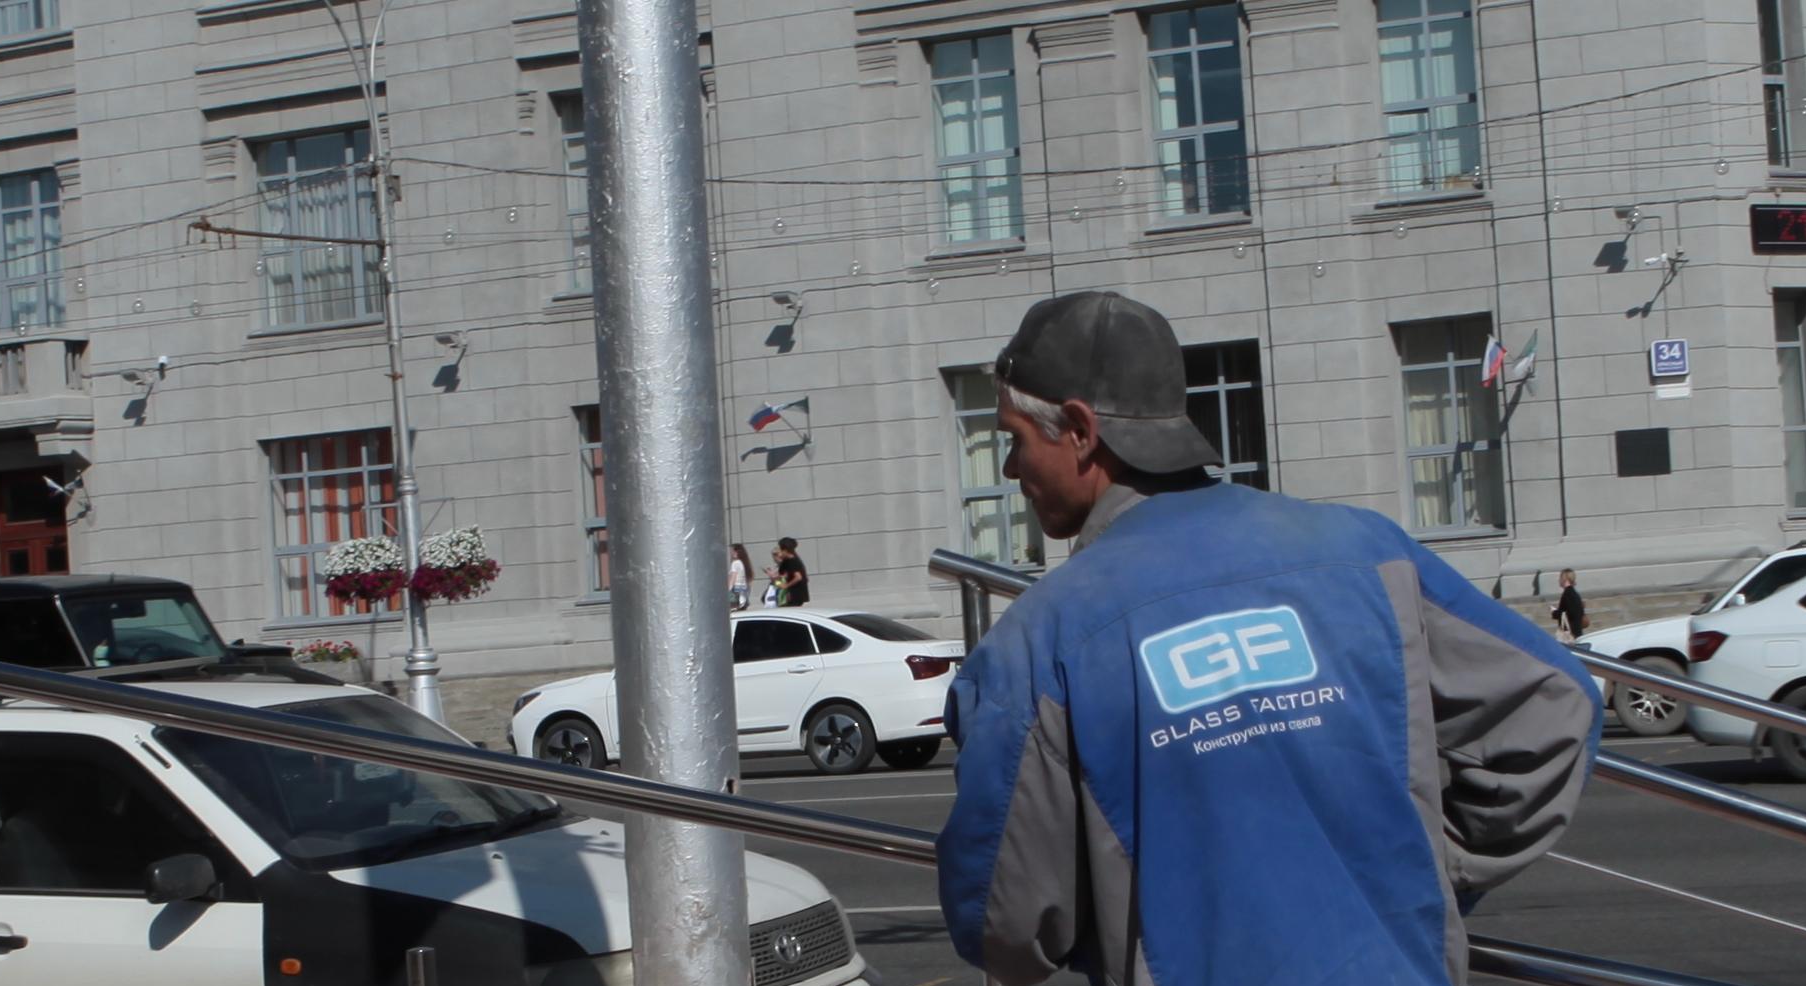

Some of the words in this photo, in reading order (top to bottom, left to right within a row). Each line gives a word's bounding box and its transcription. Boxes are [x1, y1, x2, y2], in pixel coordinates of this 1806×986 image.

[1659, 343, 1682, 360] 34
[1168, 623, 1291, 690] GF
[1150, 705, 1242, 748] GLASS
[1250, 686, 1345, 713] FACTORY
